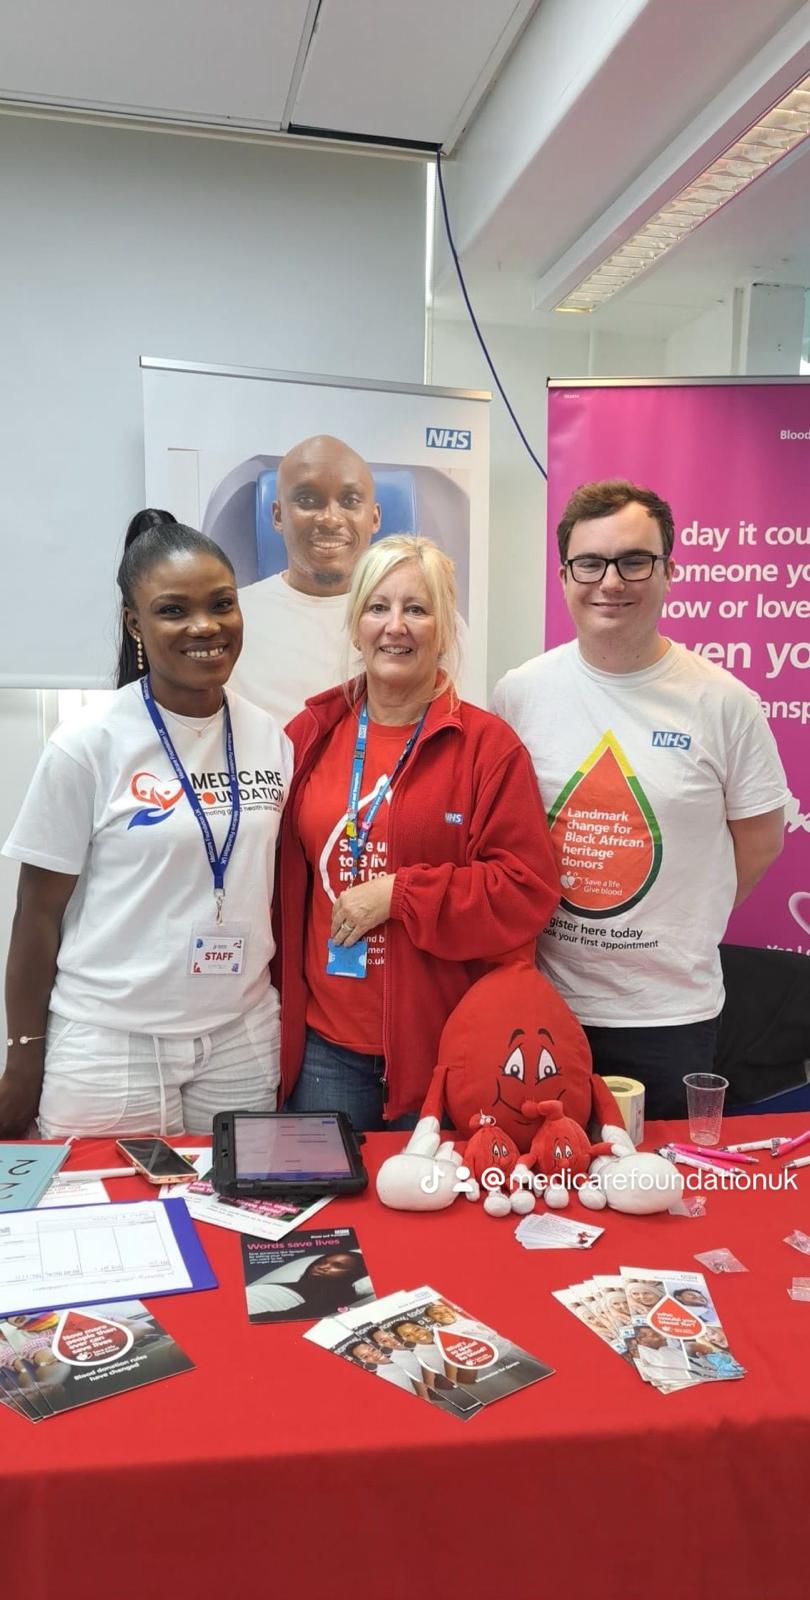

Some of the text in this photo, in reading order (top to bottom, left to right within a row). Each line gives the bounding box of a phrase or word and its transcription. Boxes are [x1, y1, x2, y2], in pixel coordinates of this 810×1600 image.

[427, 429, 470, 449] NHS
[780, 430, 810, 440] Blood
[680, 521, 810, 552] day it cou
[719, 600, 748, 618] or
[756, 594, 810, 618] love
[766, 642, 810, 679] yo
[653, 732, 691, 748] NHS
[190, 770, 284, 789] MEDCARE
[567, 808, 629, 822] Landmark
[567, 820, 632, 835] change for
[376, 841, 388, 855] u
[565, 832, 645, 849] Black African
[562, 843, 614, 859] heritage
[339, 856, 355, 868] to
[359, 855, 369, 868] 3
[561, 856, 604, 870] donors
[584, 878, 602, 888] Save
[584, 885, 623, 896] Give blood
[580, 924, 607, 937] here
[610, 928, 644, 941] today
[559, 931, 578, 944] your
[580, 936, 599, 947] first
[600, 939, 659, 951] appointment
[204, 952, 234, 961] STAFF
[247, 1242, 284, 1251] Words
[287, 1241, 313, 1249] save
[65, 1327, 117, 1347] people than
[84, 1324, 108, 1334] more
[73, 1354, 148, 1381] Blood donation rules
[88, 1362, 140, 1382] have changed
